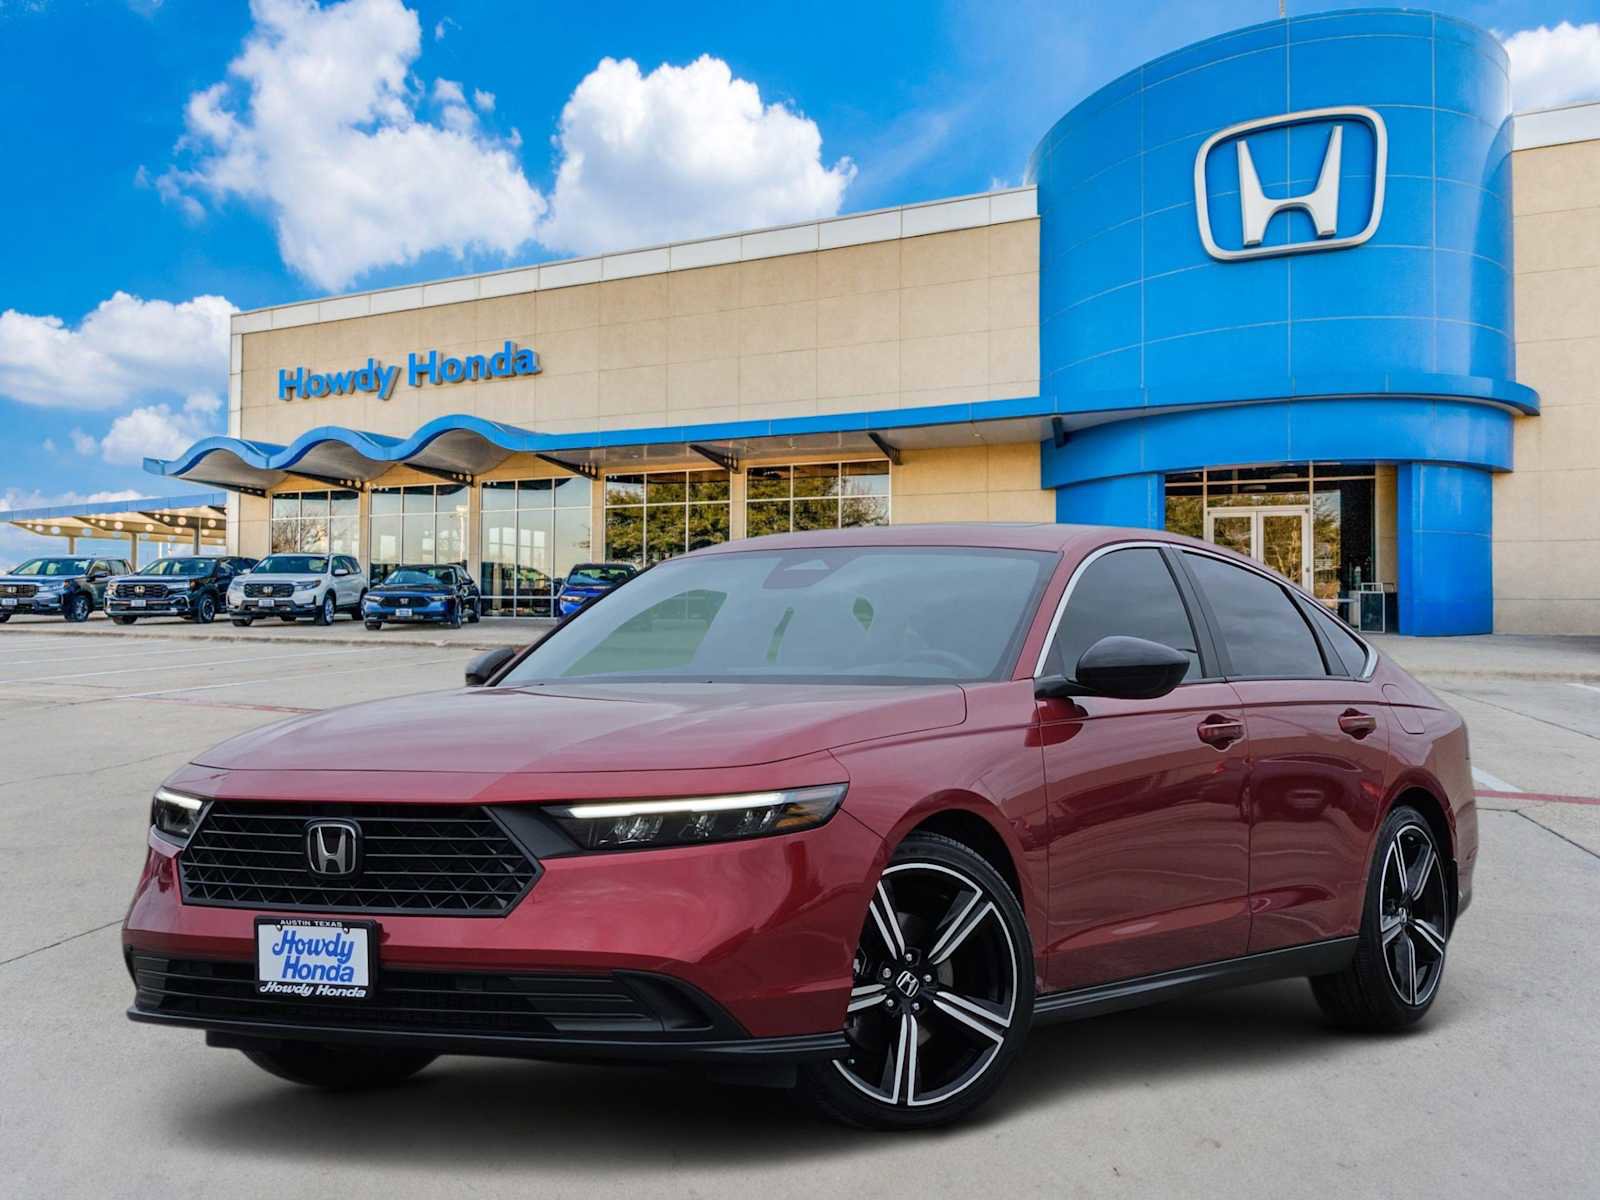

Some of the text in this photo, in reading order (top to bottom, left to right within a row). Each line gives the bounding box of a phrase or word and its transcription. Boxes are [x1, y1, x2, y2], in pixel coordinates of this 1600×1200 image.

[278, 340, 541, 401] Howdy Honda
[280, 919, 343, 928] AUSTIN TEXAS
[272, 930, 355, 965] Howdy
[281, 956, 355, 983] Honda
[260, 981, 367, 998] Howdy Honda
